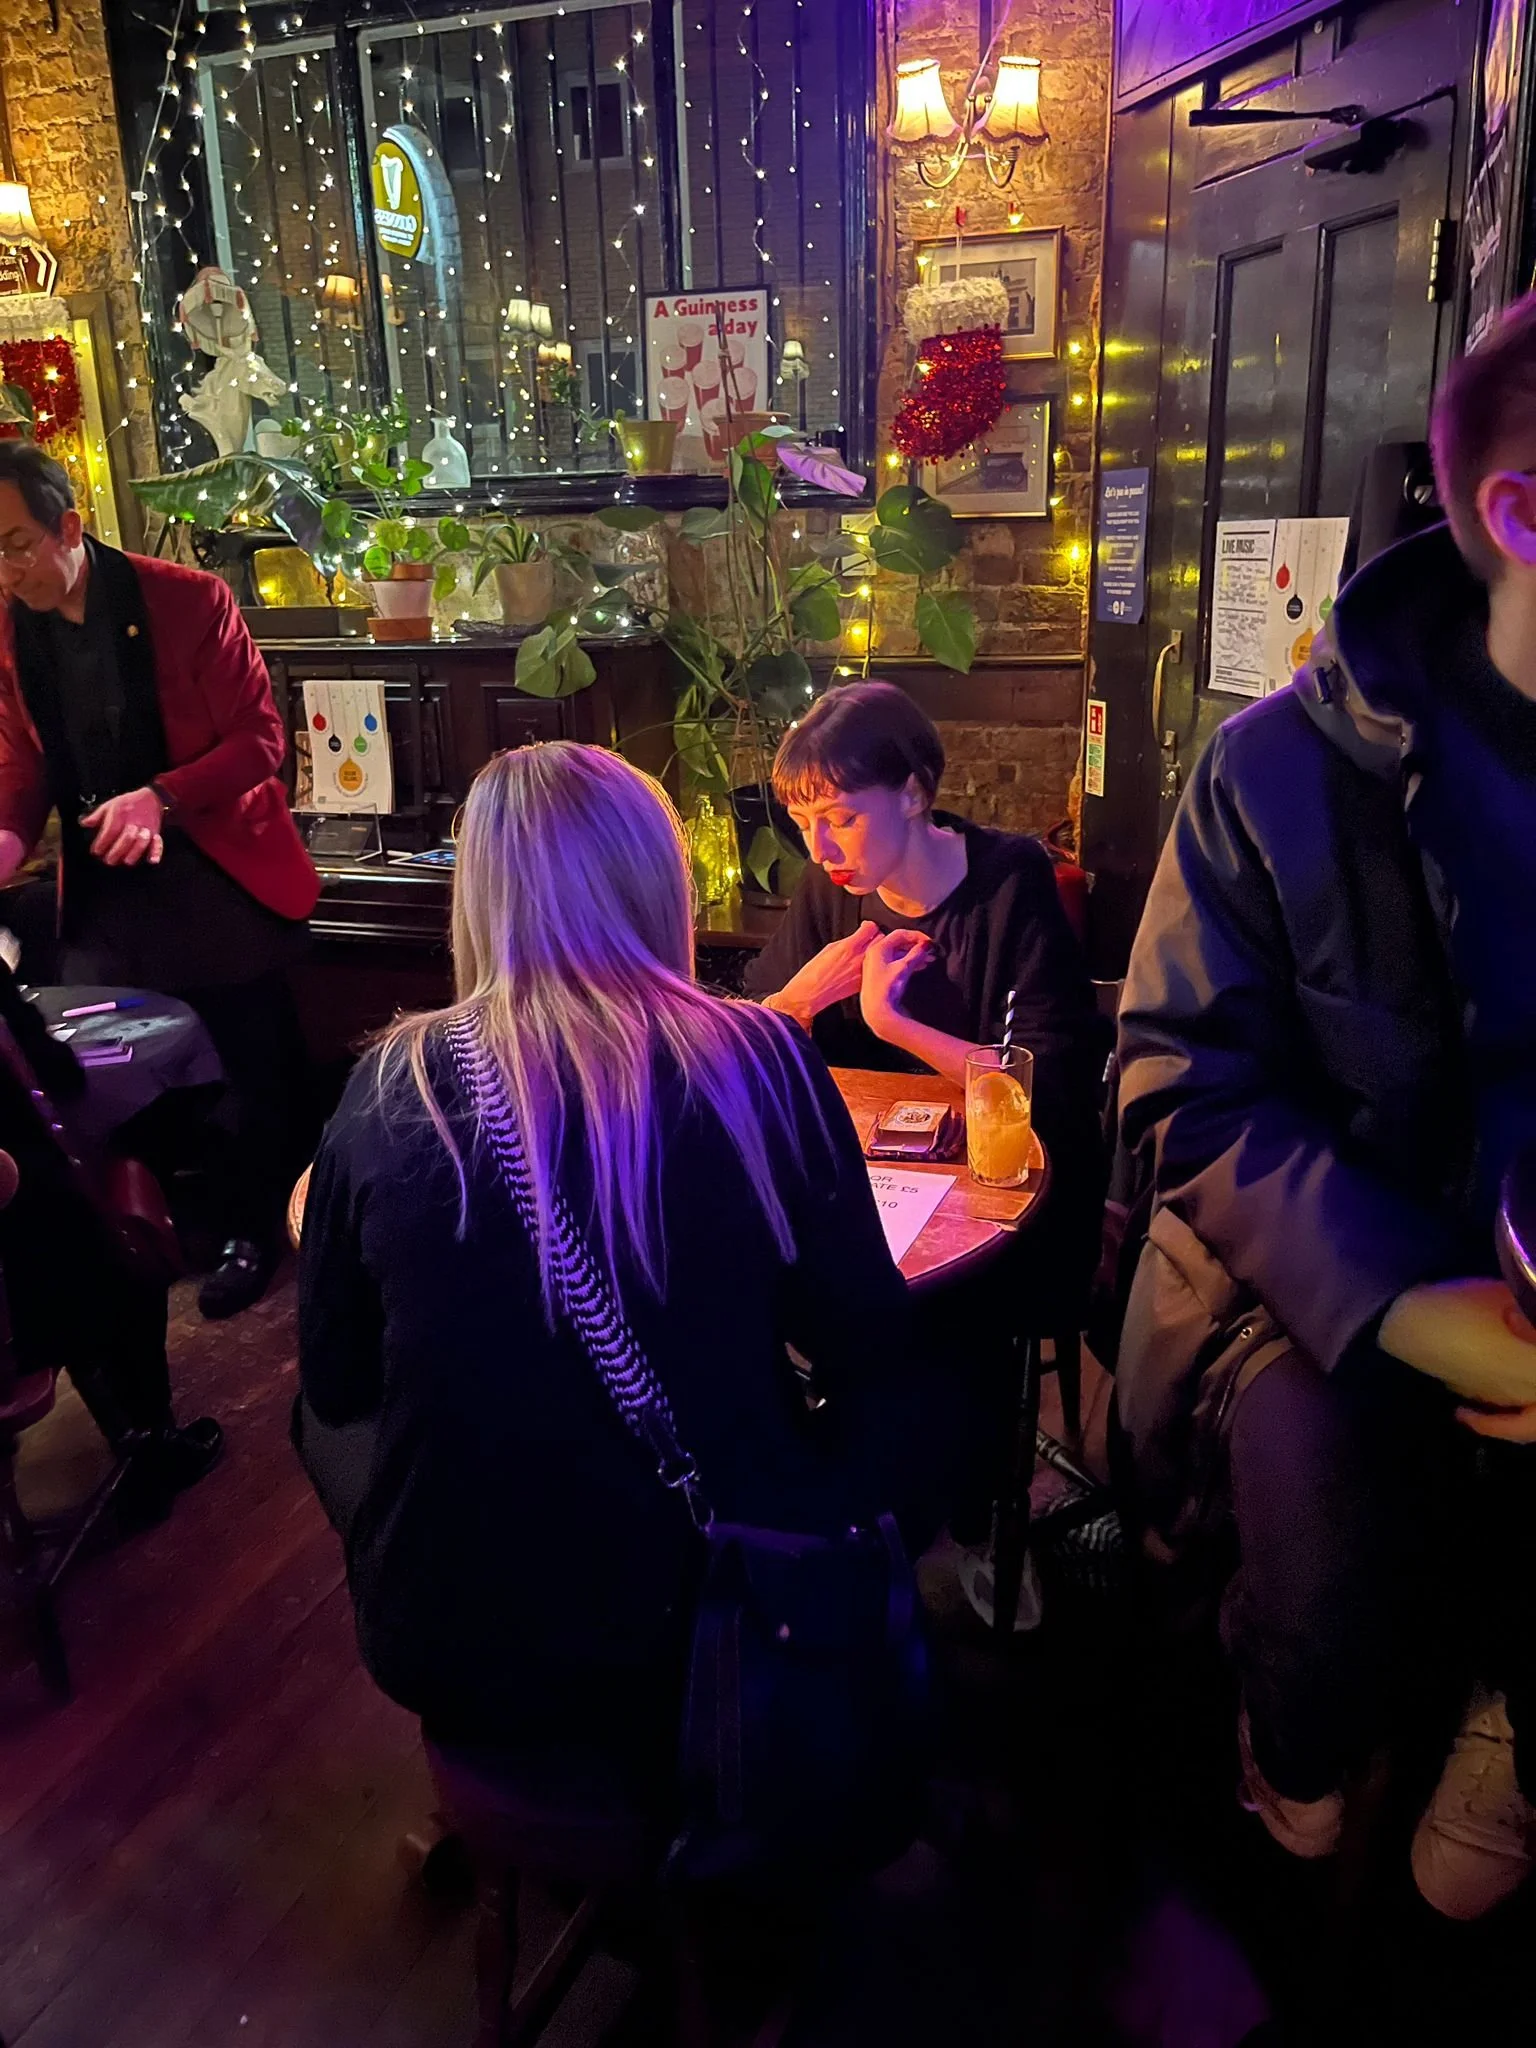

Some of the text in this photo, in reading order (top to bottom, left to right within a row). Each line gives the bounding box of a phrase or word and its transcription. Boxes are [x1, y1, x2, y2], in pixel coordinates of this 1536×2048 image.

[654, 297, 758, 318] A Guinness
[708, 318, 758, 338] a day
[1222, 539, 1255, 554] LIVE MUSIC
[900, 1186, 920, 1194] £5
[877, 1199, 898, 1209] 10
